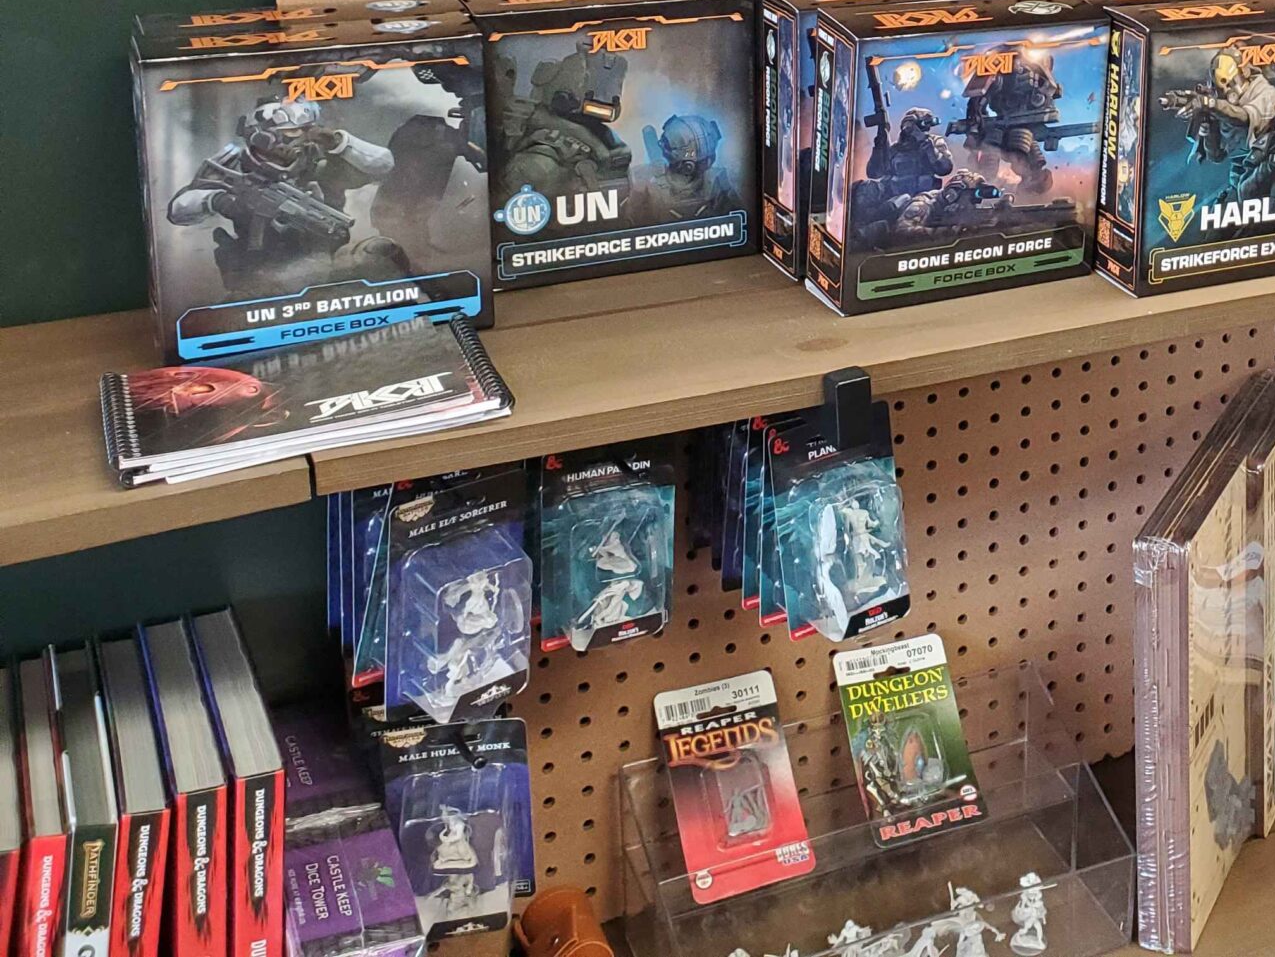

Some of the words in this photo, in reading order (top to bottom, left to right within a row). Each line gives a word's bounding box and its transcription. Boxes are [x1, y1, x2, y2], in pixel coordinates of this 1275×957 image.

[1107, 64, 1120, 161] HARLOW
[1101, 136, 1109, 206] EXPANSION
[513, 205, 541, 224] UN
[556, 189, 618, 225] UN
[512, 238, 631, 267] STRIKEFORCE
[635, 223, 734, 249] EXPANSION
[898, 254, 949, 272] BOONE
[954, 245, 1003, 263] RECON
[1008, 237, 1052, 255] FORCE
[1160, 244, 1258, 272] STRIKEFORCE
[934, 269, 982, 285] FORCE
[985, 263, 1016, 278] BOX
[246, 308, 275, 323] UN
[282, 302, 311, 319] 3RD
[317, 287, 419, 313] BATTALION
[280, 323, 345, 340] FORCE
[350, 315, 389, 332] BOX
[567, 468, 606, 483] HUMAN
[408, 521, 436, 539] MALE
[439, 515, 457, 528] ELF
[460, 500, 507, 521] SORCERER
[870, 643, 910, 657] Mockingbeast
[906, 644, 933, 658] 07070
[694, 684, 720, 695] Zombies
[731, 685, 760, 699] 30111
[848, 667, 945, 701] DUNGEON
[849, 685, 949, 719] DWELLERS
[680, 711, 757, 735] REAPER
[398, 750, 429, 763] MALE
[477, 742, 511, 754] MONK
[664, 717, 780, 768] LEGENDS
[195, 804, 207, 855] DUNGEONS
[253, 788, 266, 844] DUNGEONS
[879, 804, 983, 841] REAPER
[136, 825, 150, 878] DUNGEONS
[782, 853, 809, 865] USA
[41, 855, 54, 910] DUNGEONS
[80, 839, 105, 918] PATHFINDER
[252, 854, 265, 898] DRAGONS
[305, 862, 320, 886] DICE
[195, 869, 207, 915] DRAGONS
[312, 886, 329, 920] TOWER
[336, 890, 353, 917] KEEP
[128, 890, 143, 937] DRAGONS
